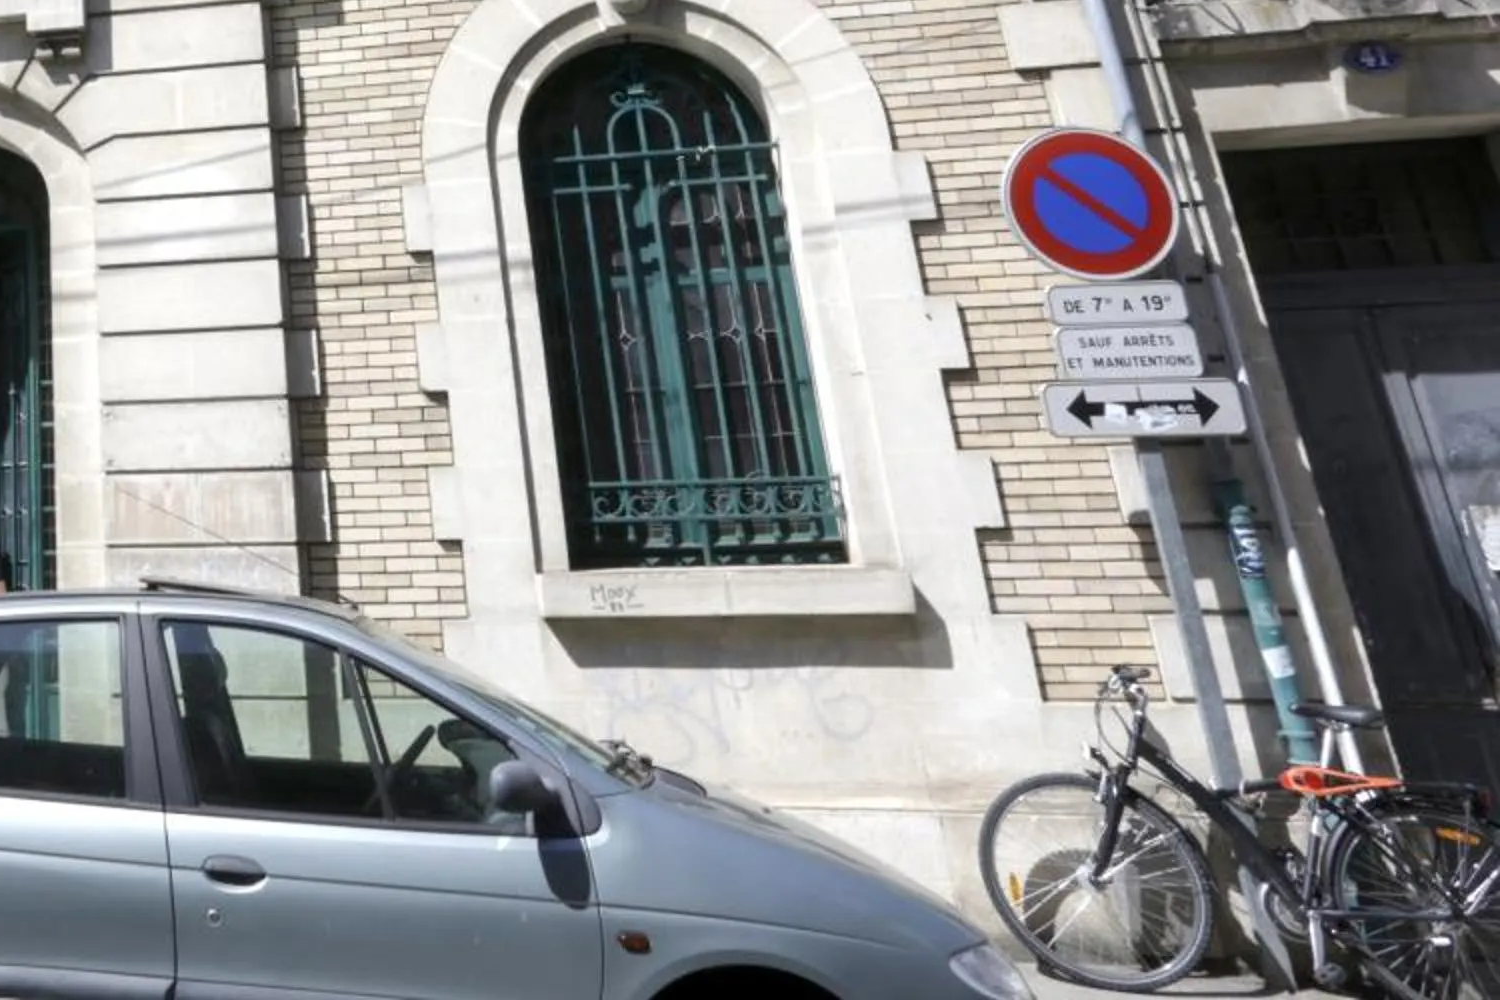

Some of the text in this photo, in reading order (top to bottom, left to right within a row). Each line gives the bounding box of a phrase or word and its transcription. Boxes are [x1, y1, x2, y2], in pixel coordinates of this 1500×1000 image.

[1063, 300, 1084, 314] DE
[1078, 336, 1112, 348] SAUF
[1067, 355, 1195, 369] ET MANUTENTIONS
